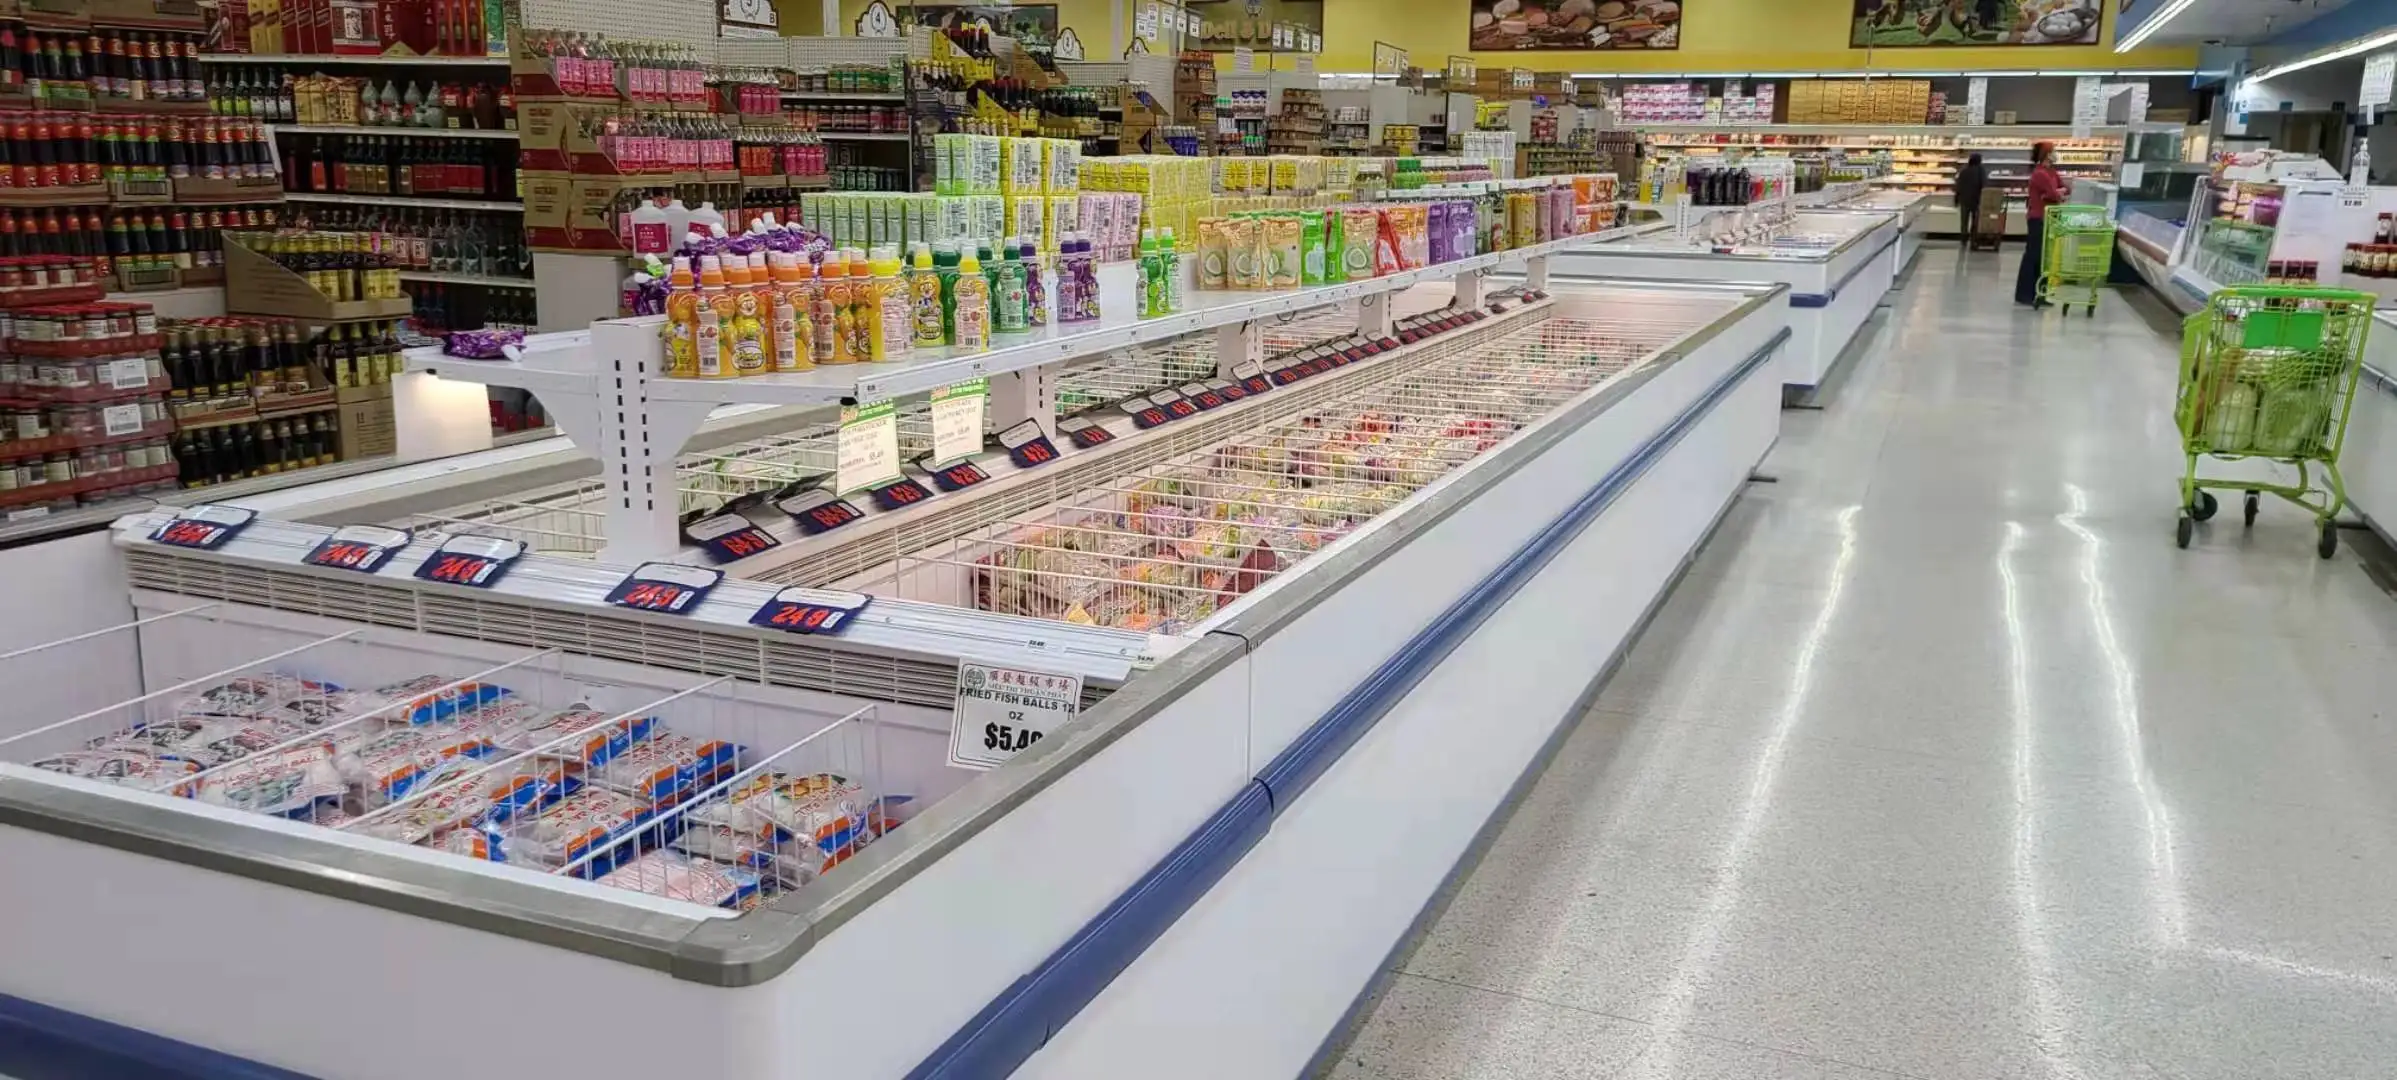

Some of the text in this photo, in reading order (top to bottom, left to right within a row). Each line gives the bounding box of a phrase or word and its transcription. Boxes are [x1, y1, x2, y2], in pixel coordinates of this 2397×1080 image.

[960, 687, 992, 700] FRIED
[994, 692, 1019, 705] FISH
[1023, 697, 1058, 711] BALLS
[1008, 711, 1024, 721] OZ
